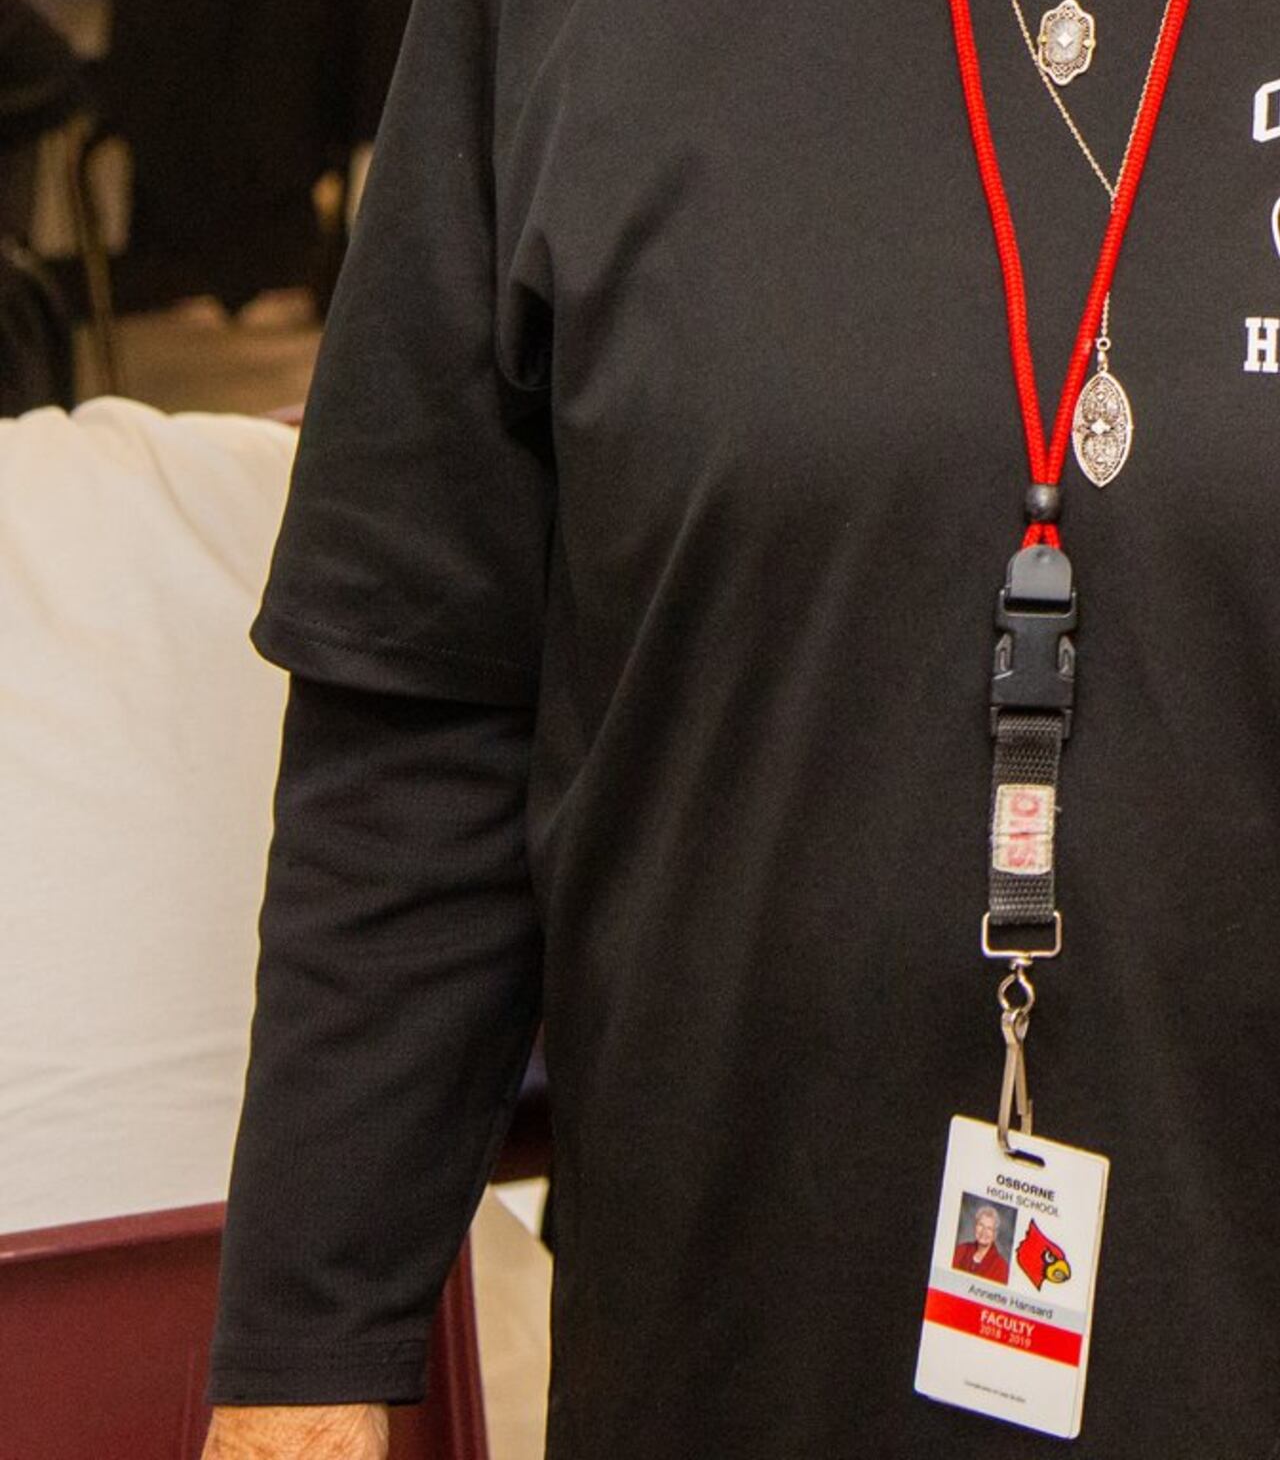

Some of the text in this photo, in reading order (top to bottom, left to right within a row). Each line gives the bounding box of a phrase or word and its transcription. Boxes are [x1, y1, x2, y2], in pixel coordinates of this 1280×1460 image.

[986, 1186, 1059, 1217] HIGH SCHOOL
[996, 1174, 1055, 1201] OSBORNE
[980, 1308, 1036, 1338] FACULTY
